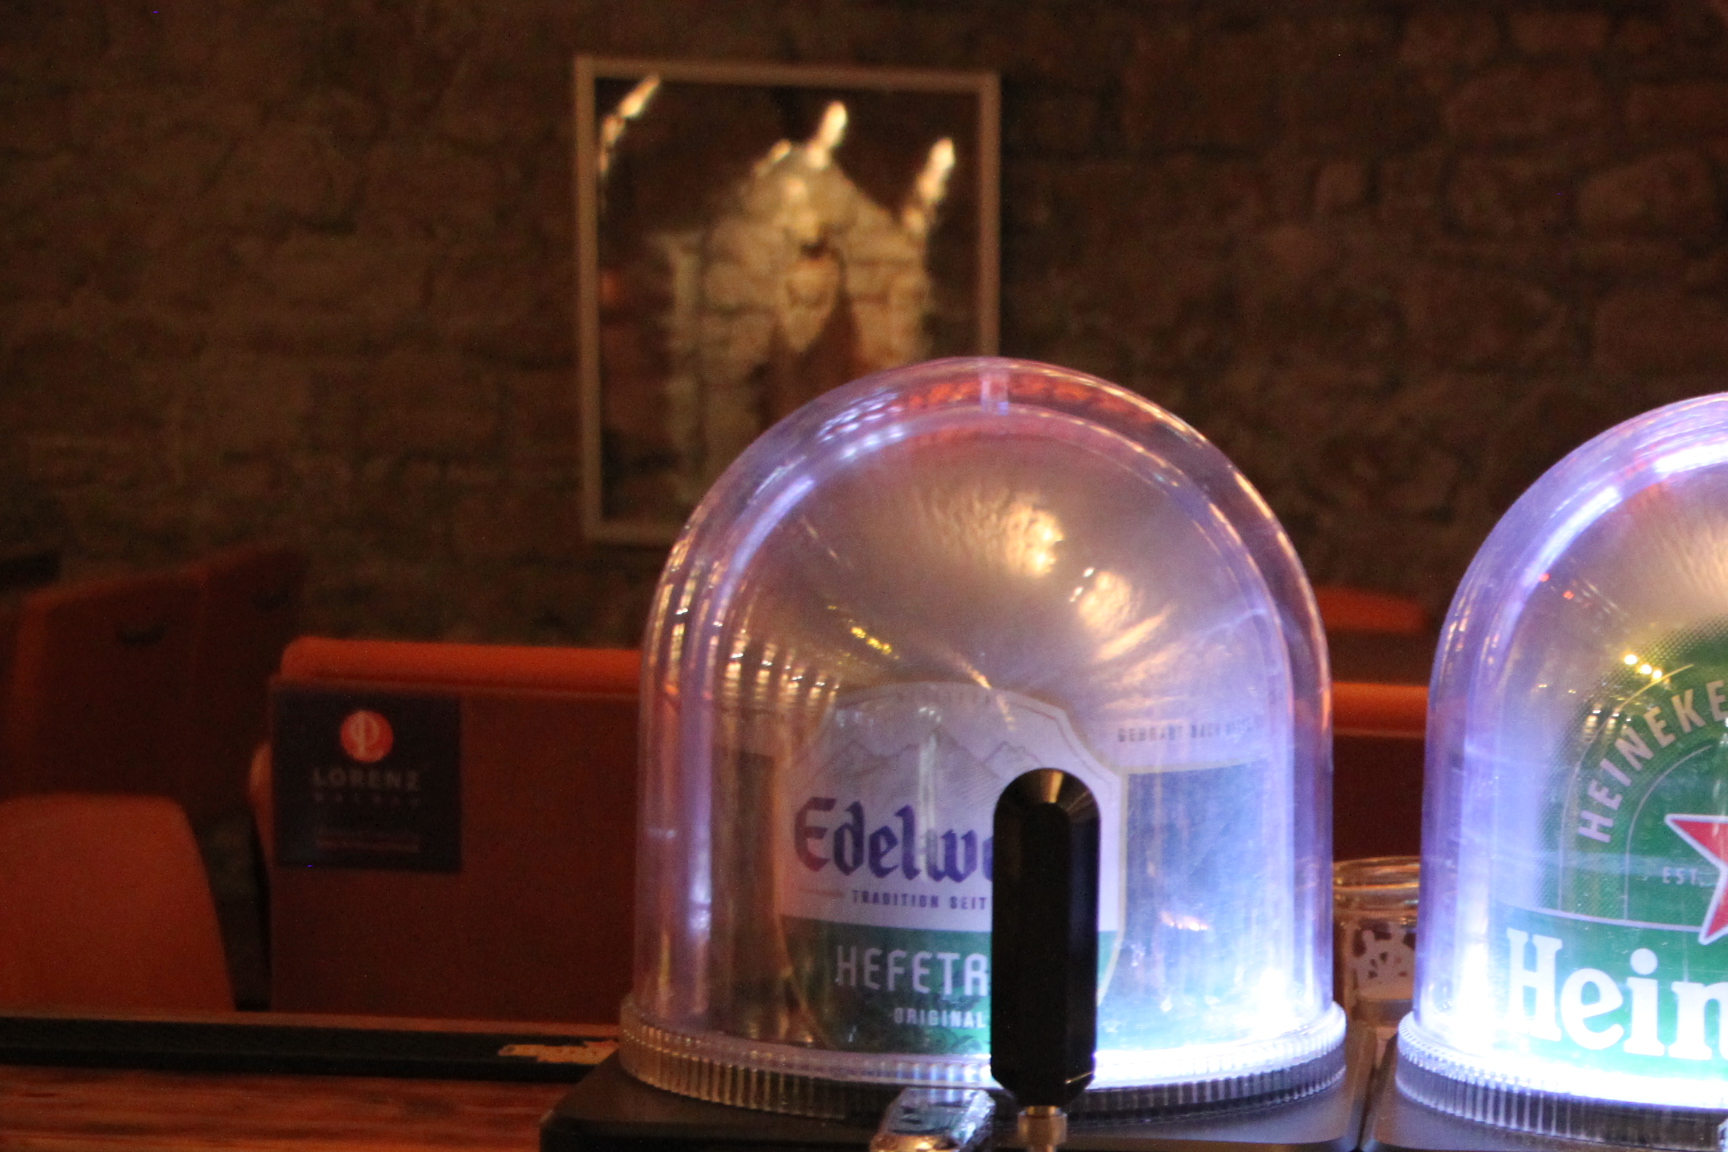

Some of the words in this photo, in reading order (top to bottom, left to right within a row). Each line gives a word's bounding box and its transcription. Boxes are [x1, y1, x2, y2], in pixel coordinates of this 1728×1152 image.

[852, 889, 940, 908] TRADITION
[949, 895, 988, 910] SEIT
[836, 944, 990, 997] HEFETR
[893, 1007, 987, 1029] ORIGINAL
